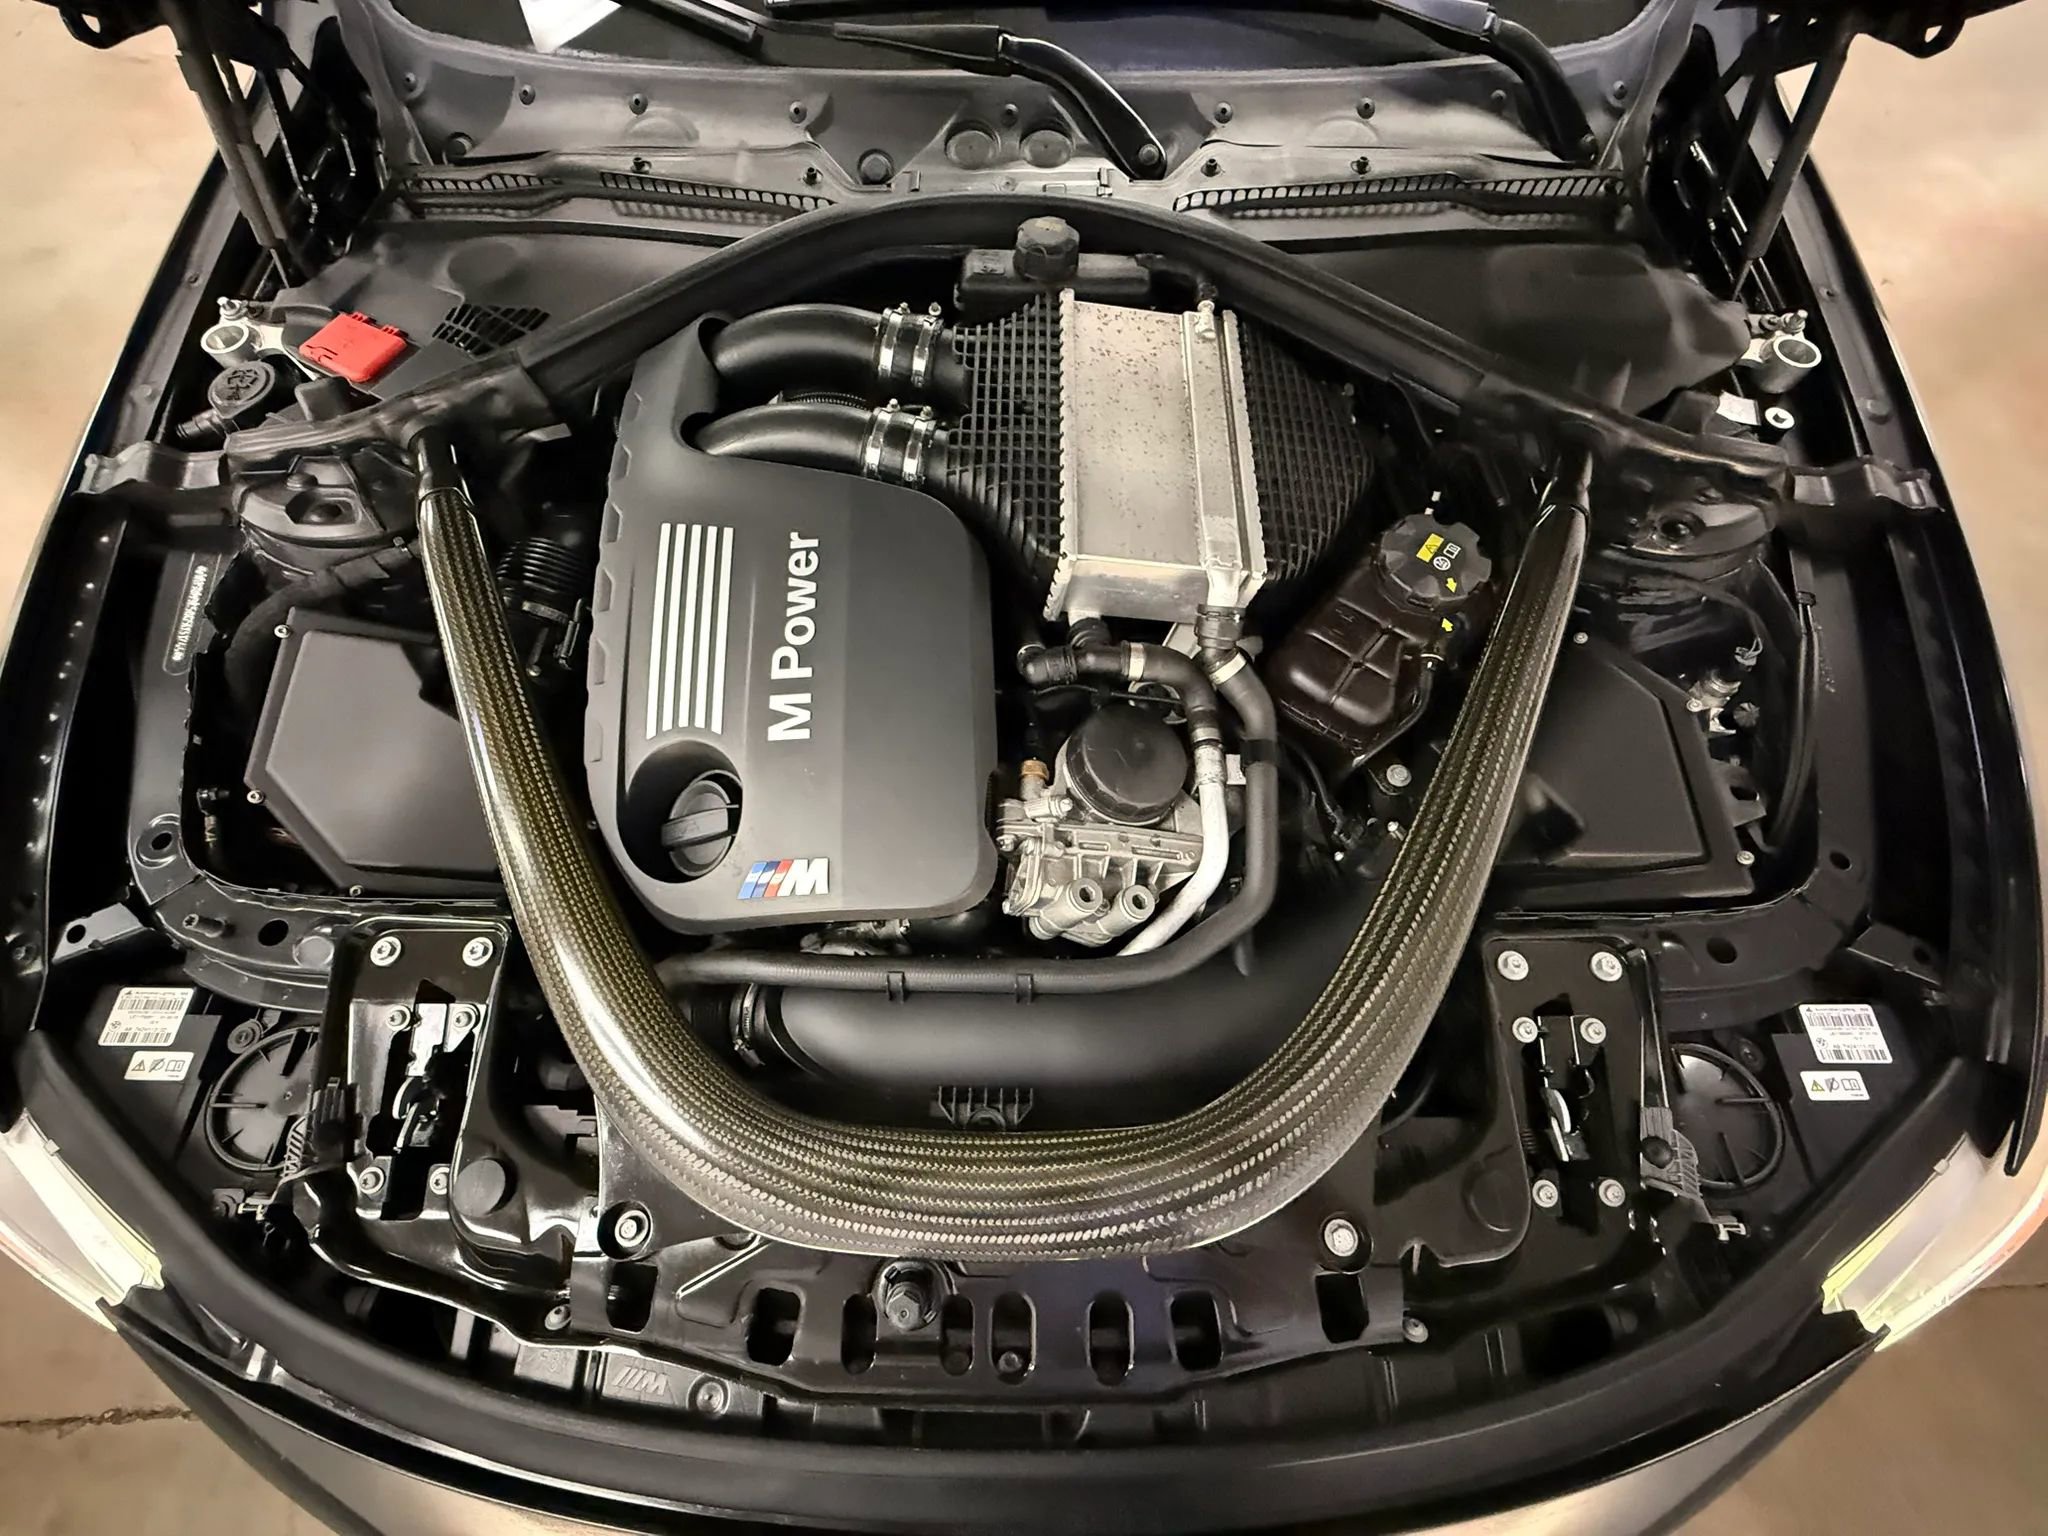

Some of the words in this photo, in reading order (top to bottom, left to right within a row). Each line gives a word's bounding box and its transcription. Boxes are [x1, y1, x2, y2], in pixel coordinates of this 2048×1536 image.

[770, 531, 820, 680] Power
[767, 692, 812, 741] M
[776, 857, 830, 896] M
